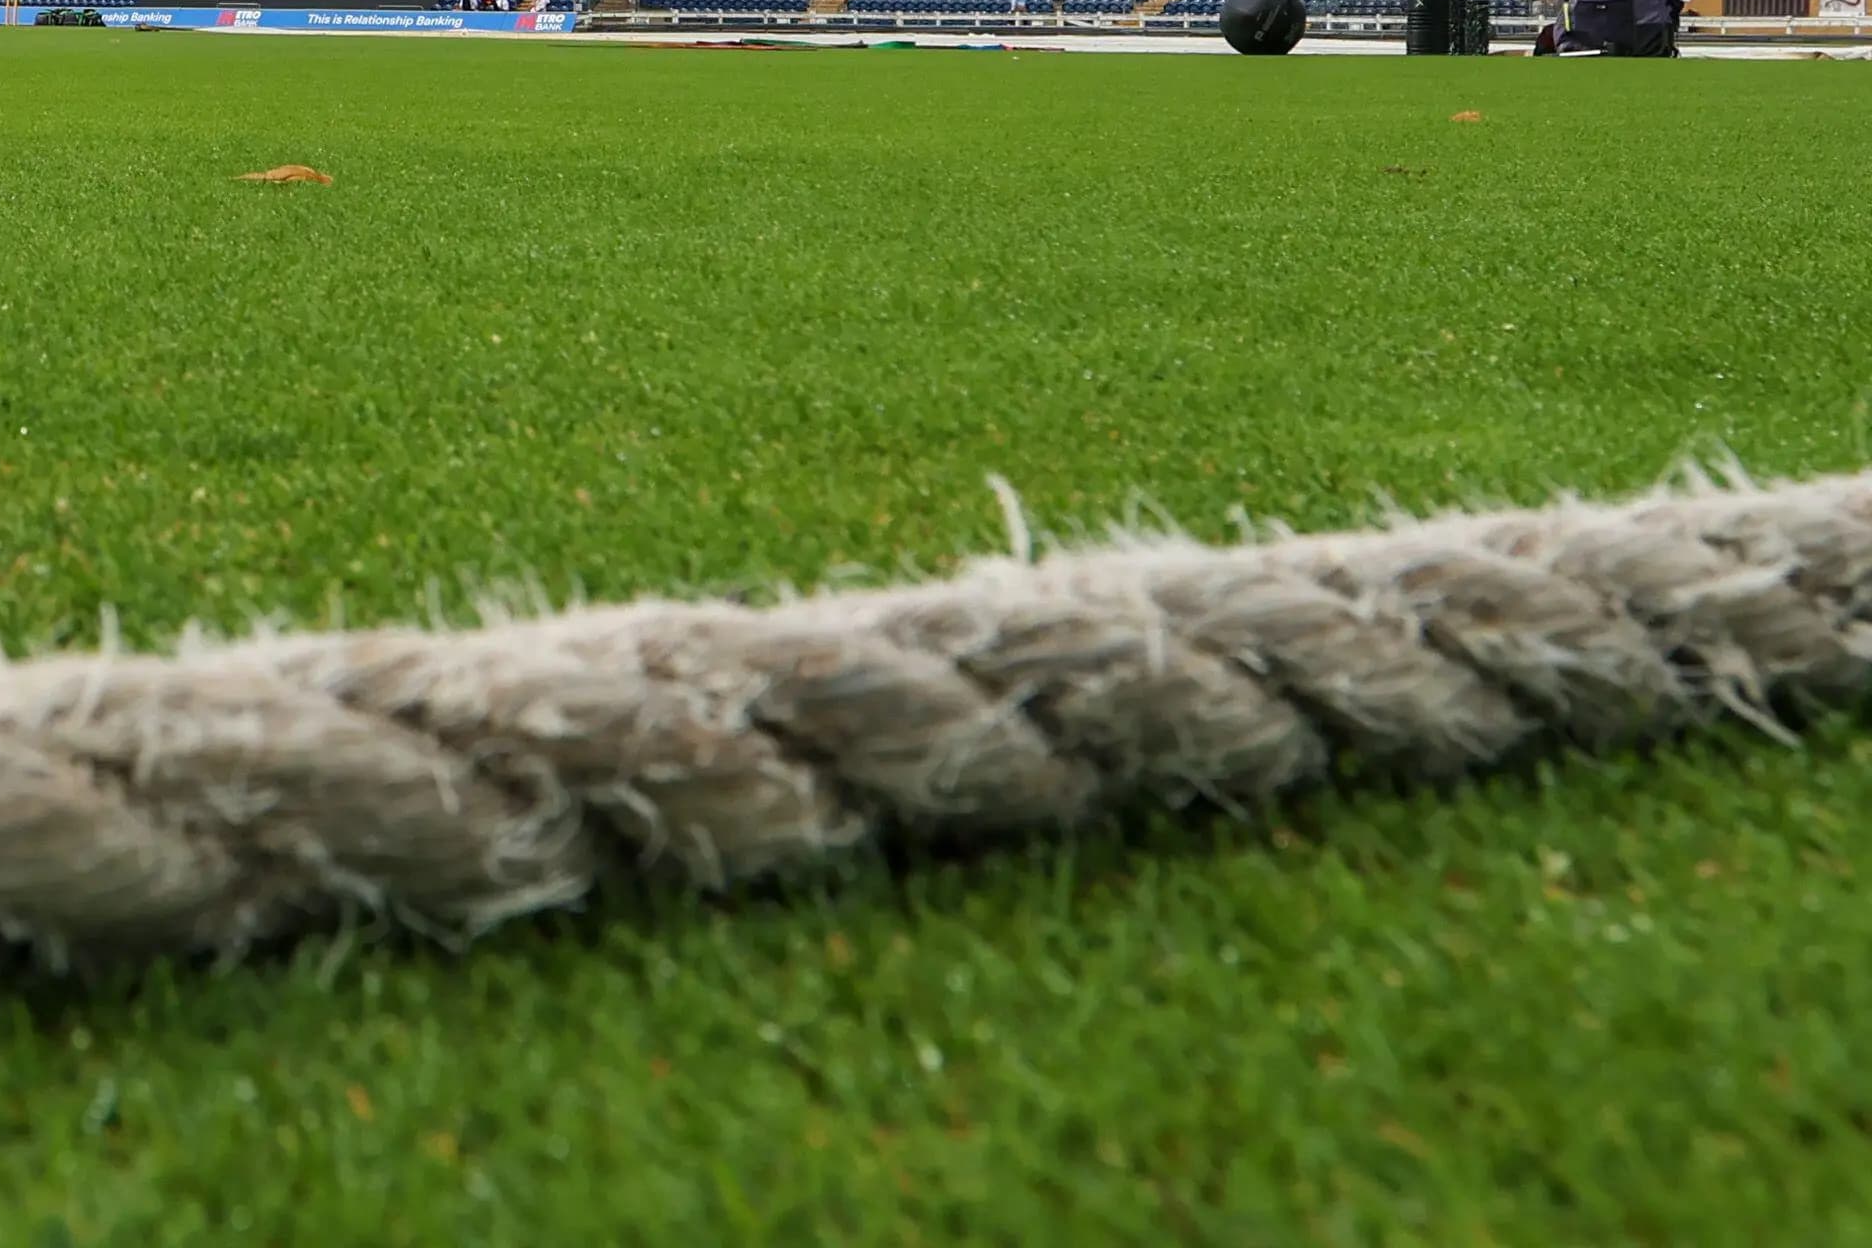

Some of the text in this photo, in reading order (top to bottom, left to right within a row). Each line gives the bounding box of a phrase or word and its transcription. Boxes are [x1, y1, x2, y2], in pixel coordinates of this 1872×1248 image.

[130, 11, 172, 24] Banking
[307, 13, 463, 29] This is Relationship Banking
[535, 23, 563, 31] BANK
